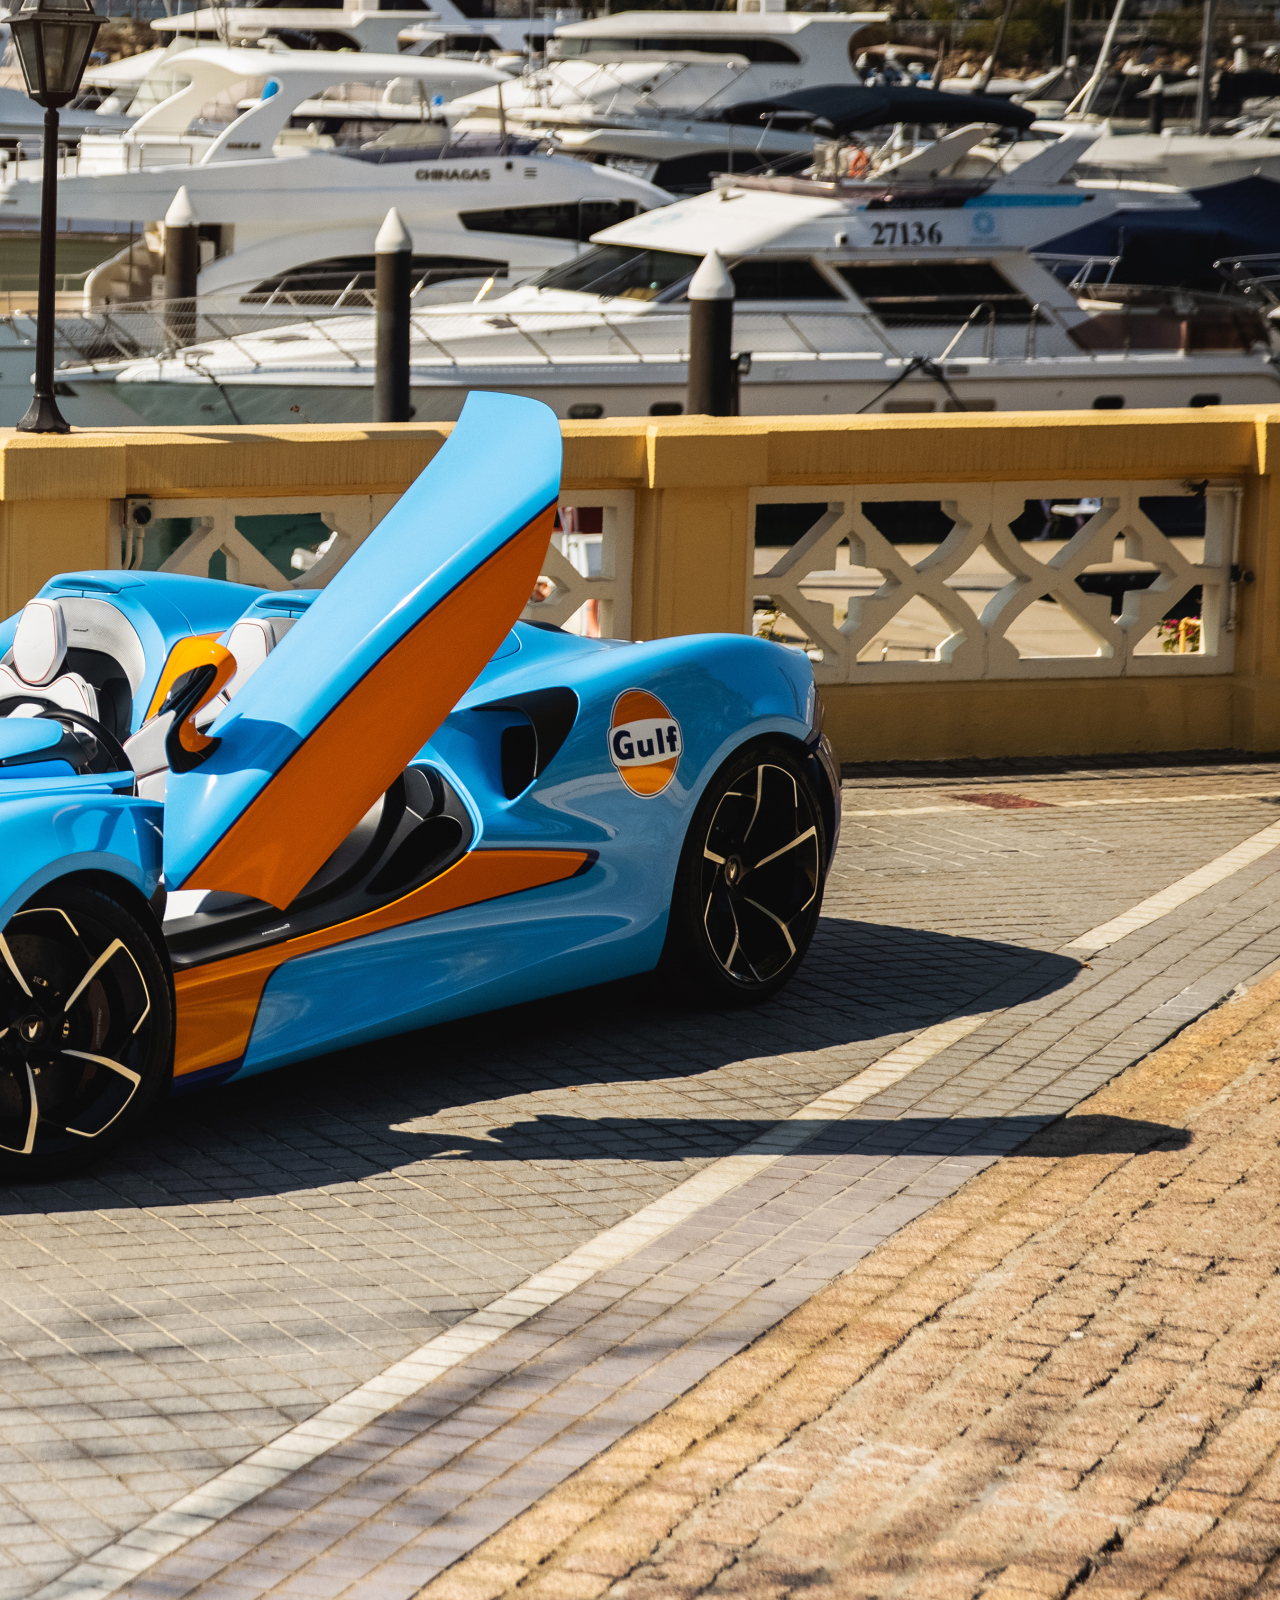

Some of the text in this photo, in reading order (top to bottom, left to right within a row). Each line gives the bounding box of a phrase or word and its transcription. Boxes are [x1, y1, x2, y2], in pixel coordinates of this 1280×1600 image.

[415, 168, 491, 181] CHINAGAS
[870, 221, 943, 246] 27136
[613, 726, 678, 760] Gulf
